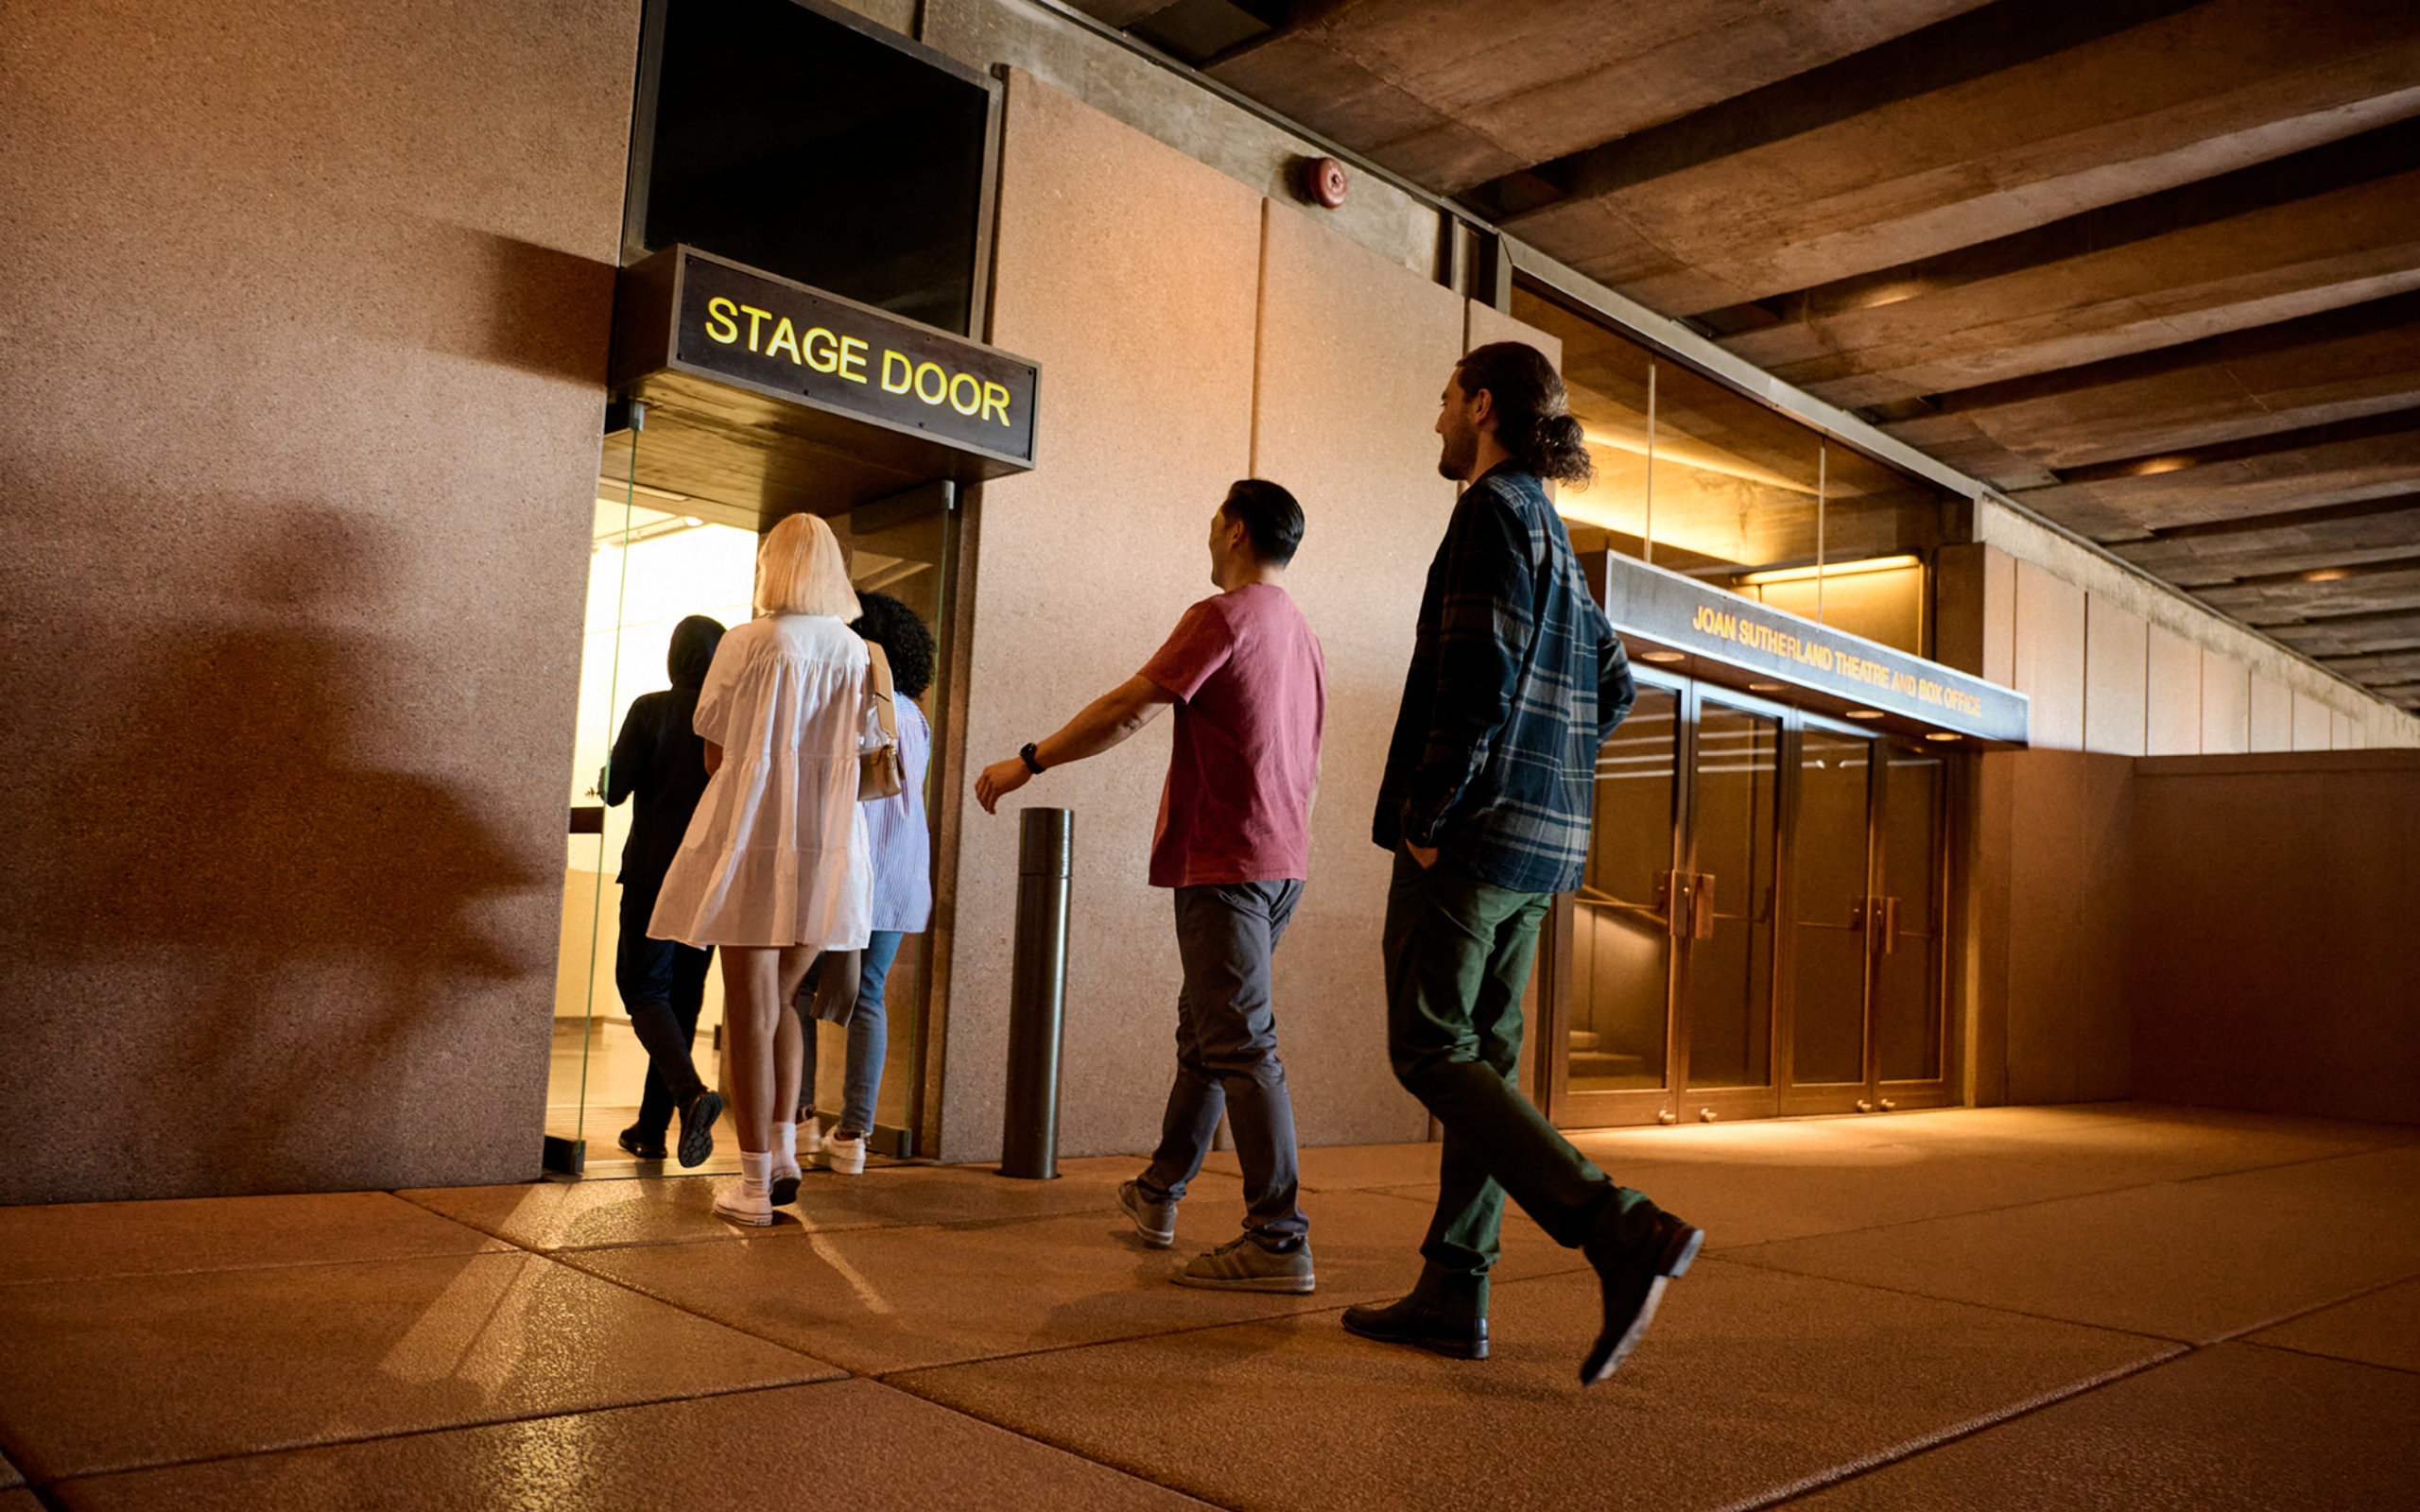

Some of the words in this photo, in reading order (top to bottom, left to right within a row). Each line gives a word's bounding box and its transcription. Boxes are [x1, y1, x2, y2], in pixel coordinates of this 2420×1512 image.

[704, 297, 870, 385] STAGE
[881, 349, 1011, 427] DOOR
[1692, 606, 1737, 642] JOAN
[1738, 619, 1833, 672] SUTHERLAND
[1835, 651, 1890, 690] THEATRE
[1891, 671, 1917, 697] AND
[1917, 680, 1944, 706] BOX
[1944, 688, 1982, 718] OFFICE
